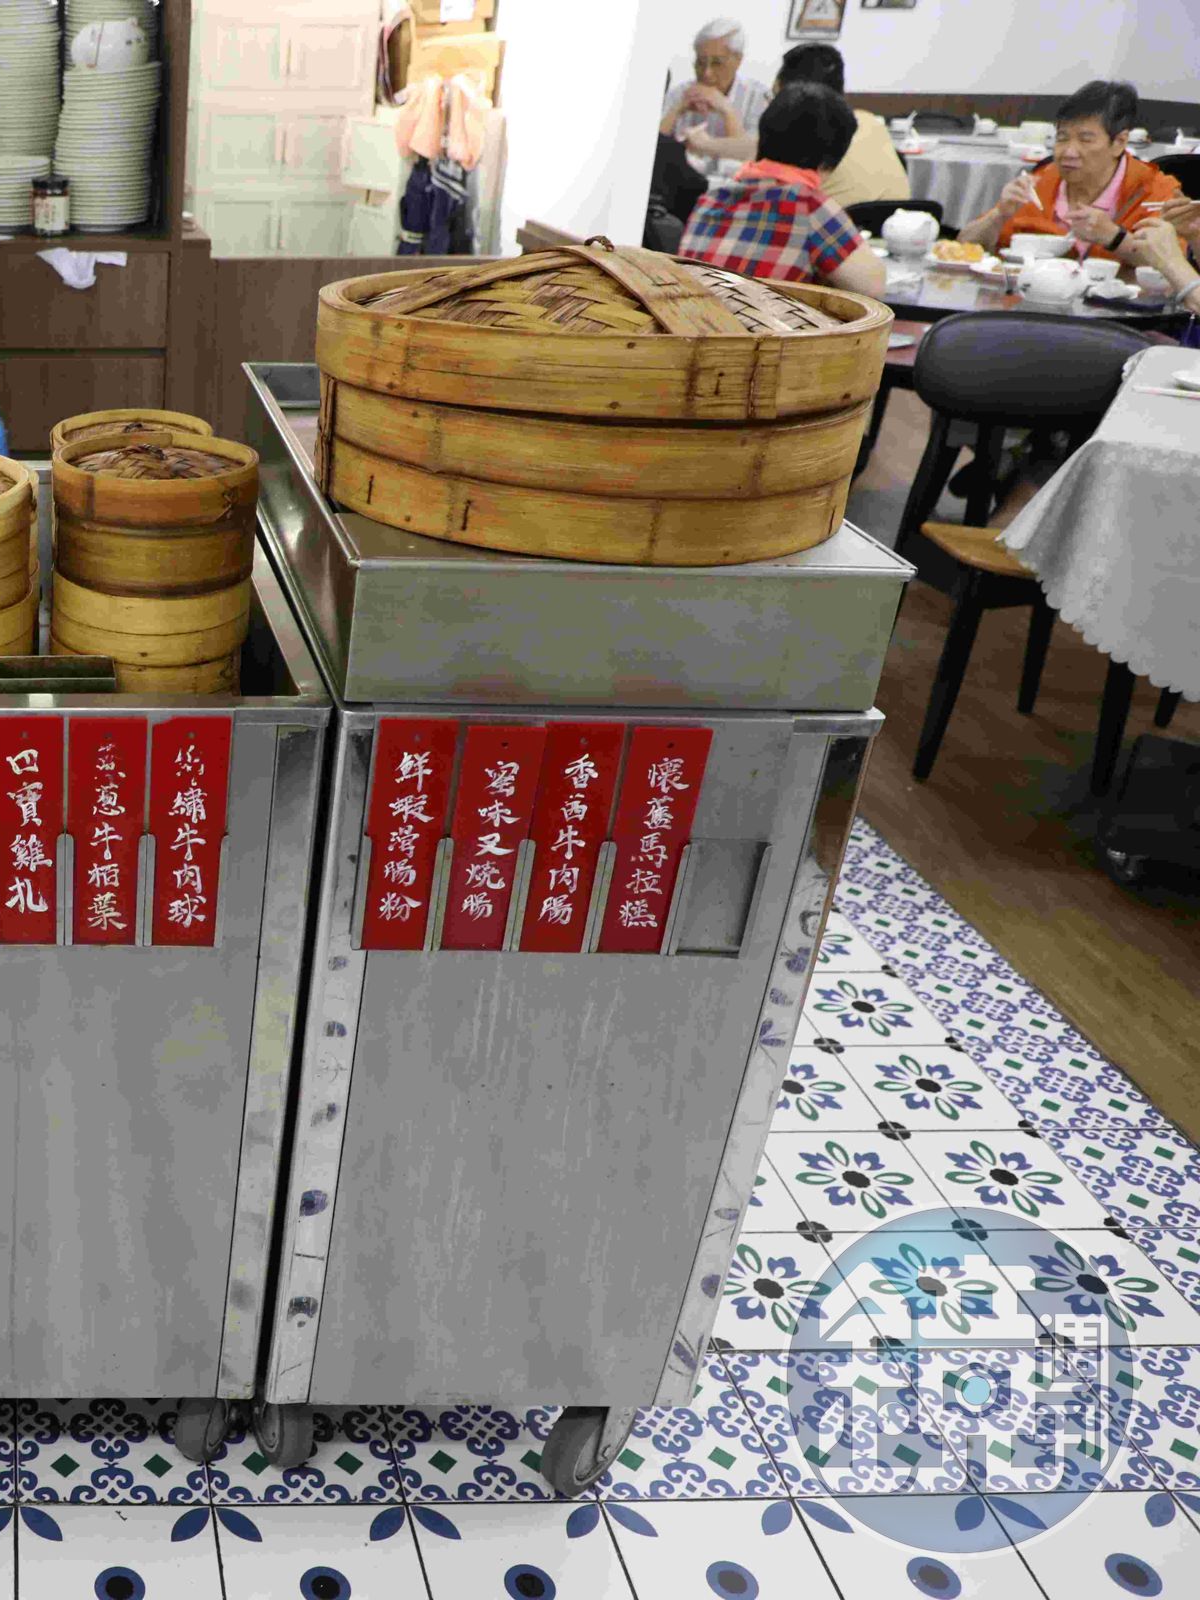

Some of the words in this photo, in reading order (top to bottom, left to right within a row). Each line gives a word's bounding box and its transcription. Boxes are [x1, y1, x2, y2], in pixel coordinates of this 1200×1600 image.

[378, 751, 435, 920] 鮮蝦滑腸粉
[537, 753, 599, 925] 香茜牛肉腸
